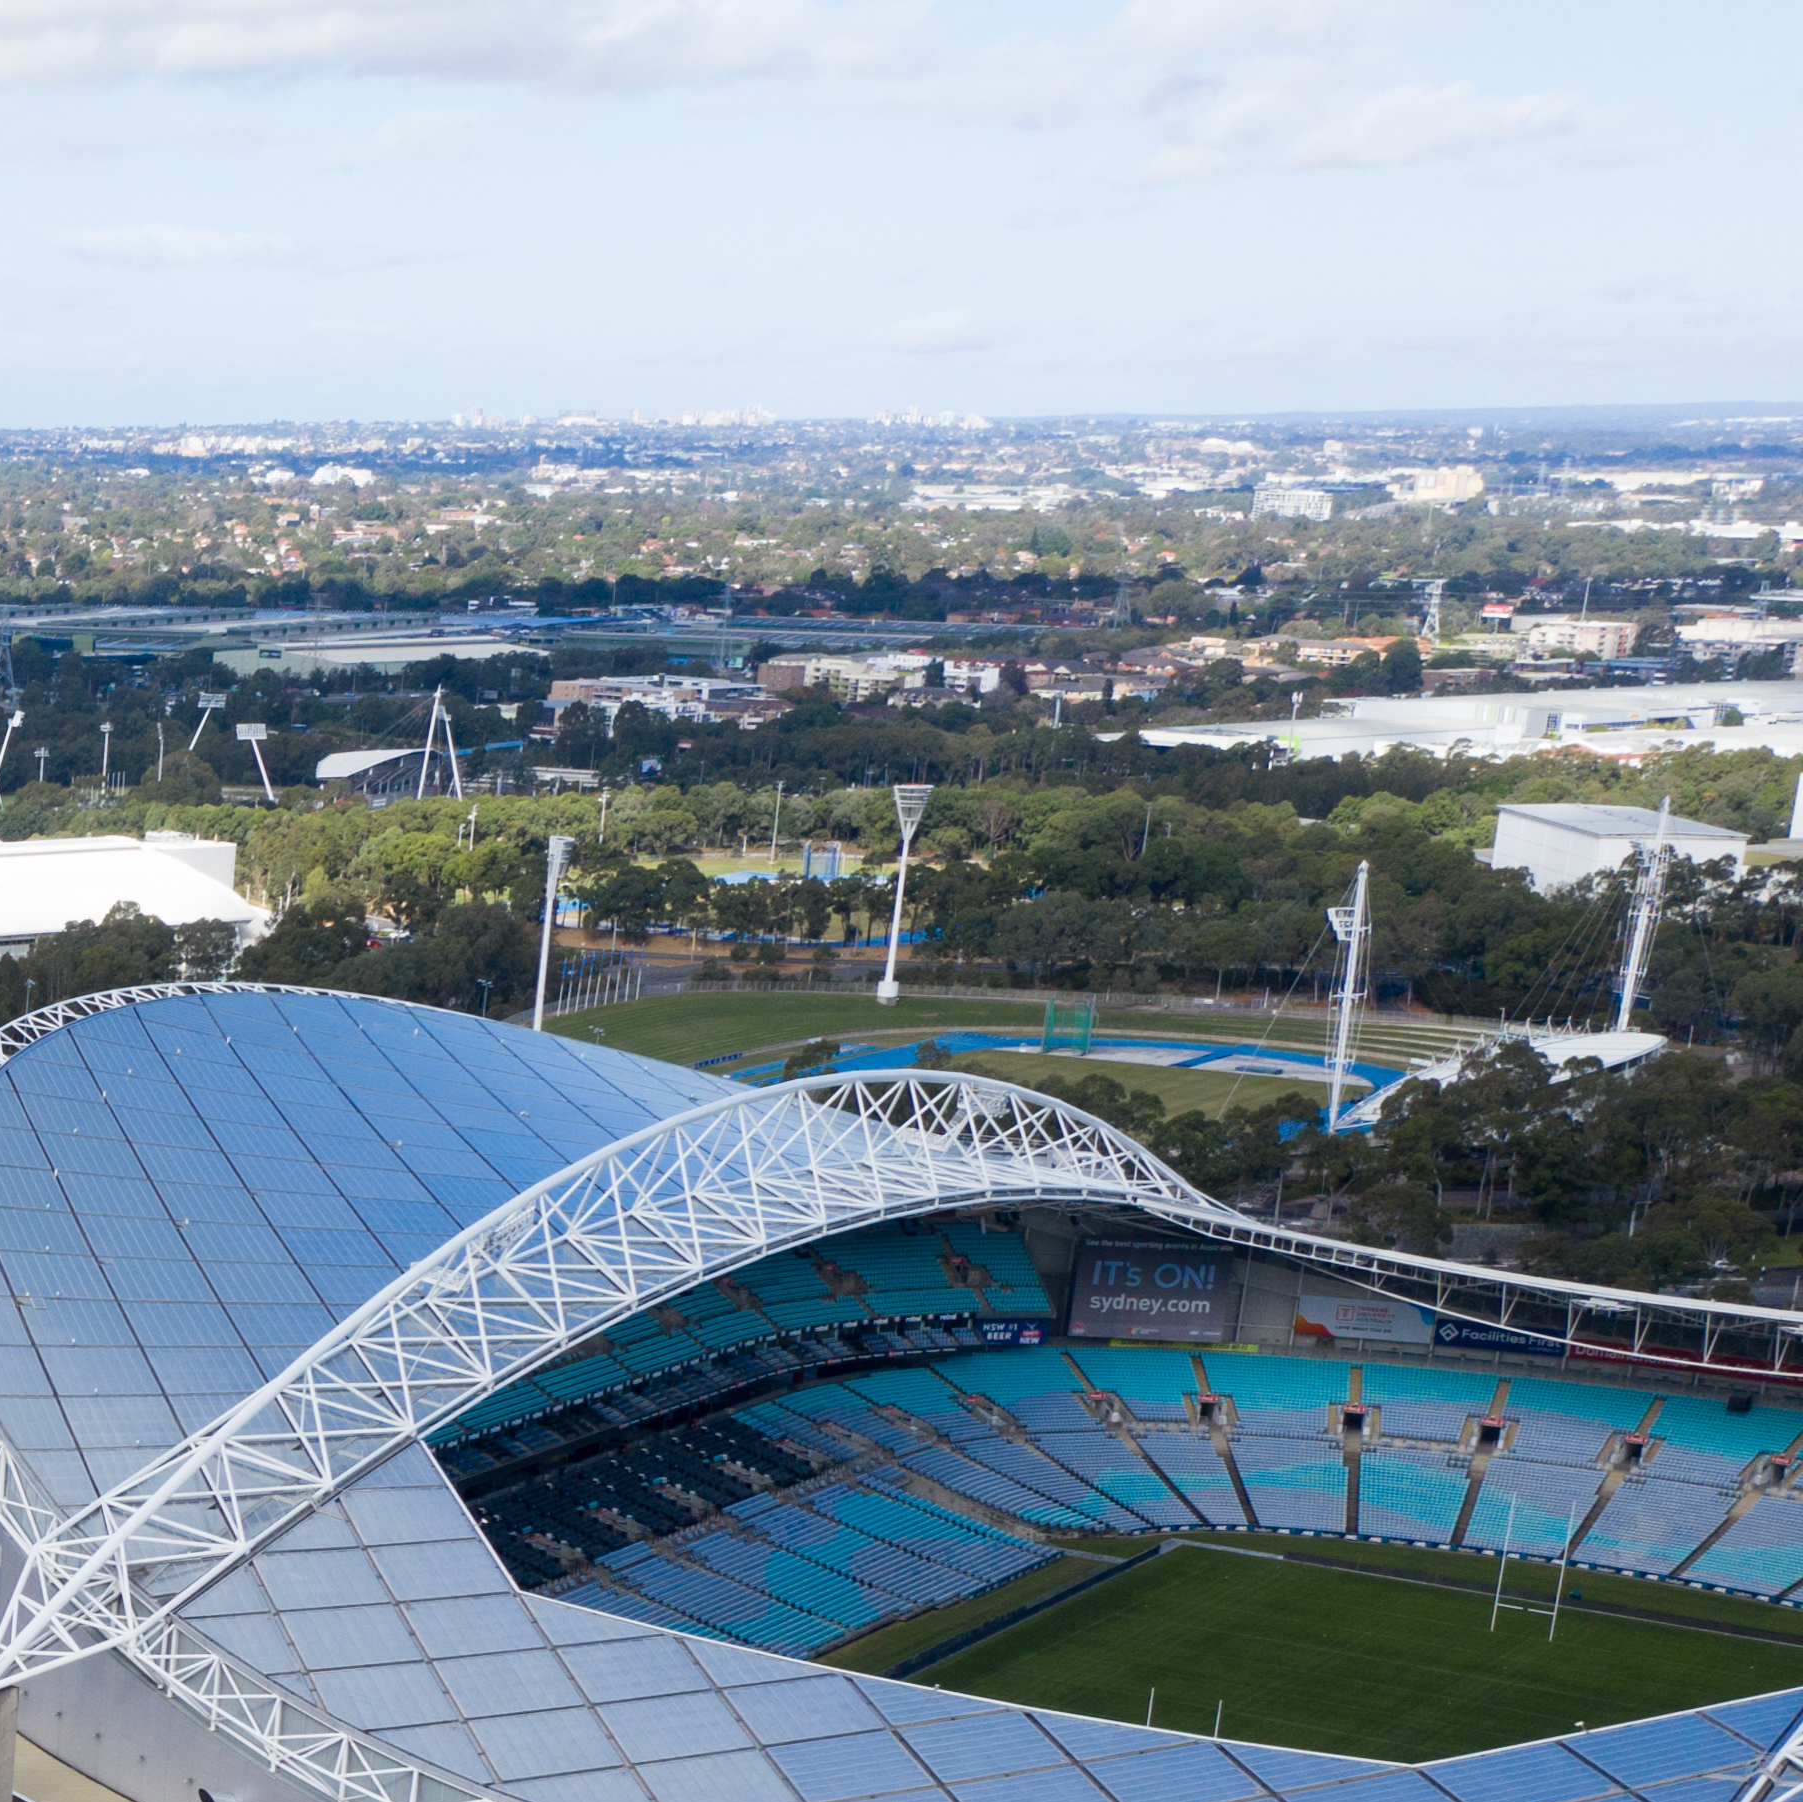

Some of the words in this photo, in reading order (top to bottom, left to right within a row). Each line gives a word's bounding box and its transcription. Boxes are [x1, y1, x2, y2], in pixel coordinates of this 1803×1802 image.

[1154, 1263, 1216, 1290] ON!
[1090, 1293, 1210, 1315] sydney.com
[983, 1323, 1005, 1331] NSW
[986, 1332, 1012, 1341] BEER
[1461, 1329, 1526, 1345] Facilities
[1528, 1336, 1562, 1348] First
